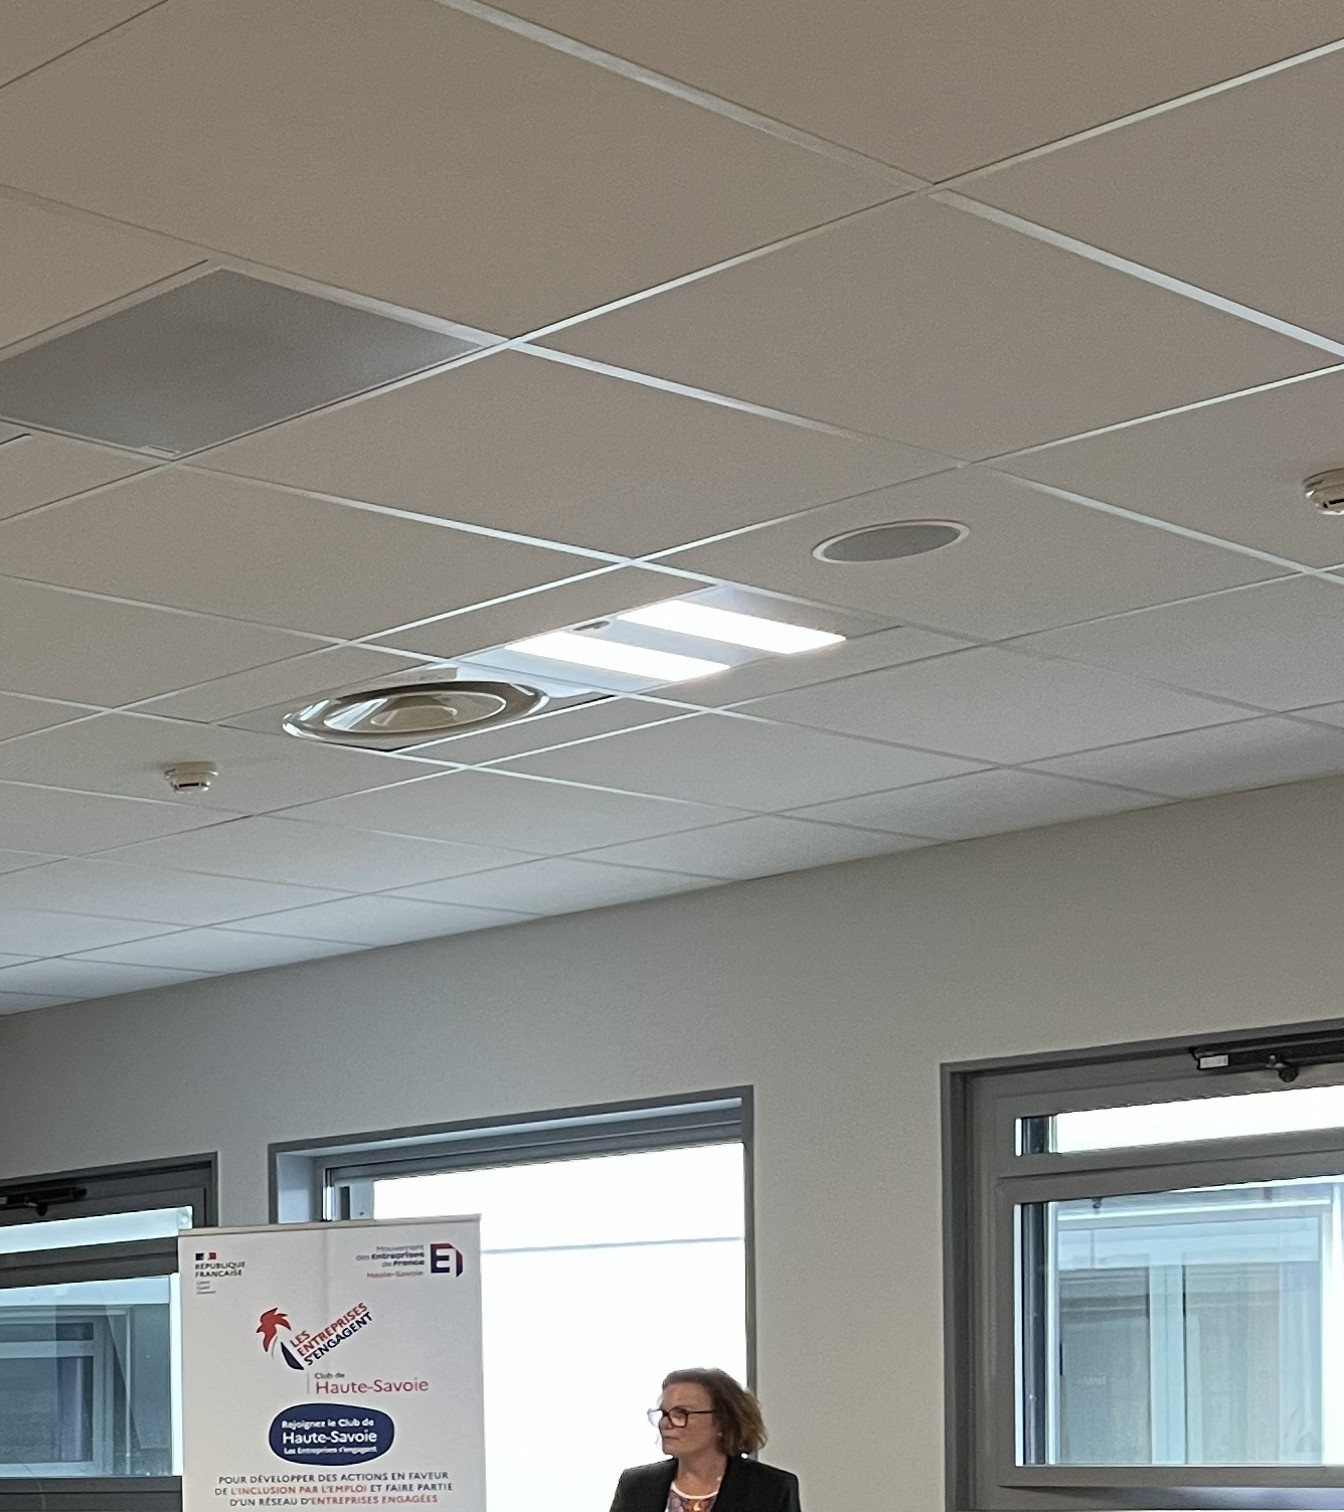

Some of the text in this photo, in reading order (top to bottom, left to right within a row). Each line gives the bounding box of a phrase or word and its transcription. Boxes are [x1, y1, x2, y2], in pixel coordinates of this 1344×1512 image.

[393, 1259, 425, 1267] France
[296, 1302, 368, 1357] ENTREPRISES
[289, 1329, 311, 1348] LES
[304, 1311, 373, 1366] S'ENGAGENT
[314, 1372, 334, 1380] Club
[315, 1377, 429, 1395] Haute-Savoie
[281, 1418, 374, 1430] Rejoignez le Club de
[282, 1429, 378, 1445] Haute-Savoie
[218, 1471, 449, 1484] POUR DÉVELOPPER DES ACTIONS EN FAVEUR
[214, 1482, 453, 1496] DE L'INCLUSION PAR L'EMPLOI ET FAIRE PARTIE
[230, 1493, 438, 1506] D'UN RÉSEAU D'ENTREPRISES ENGAGÉES
